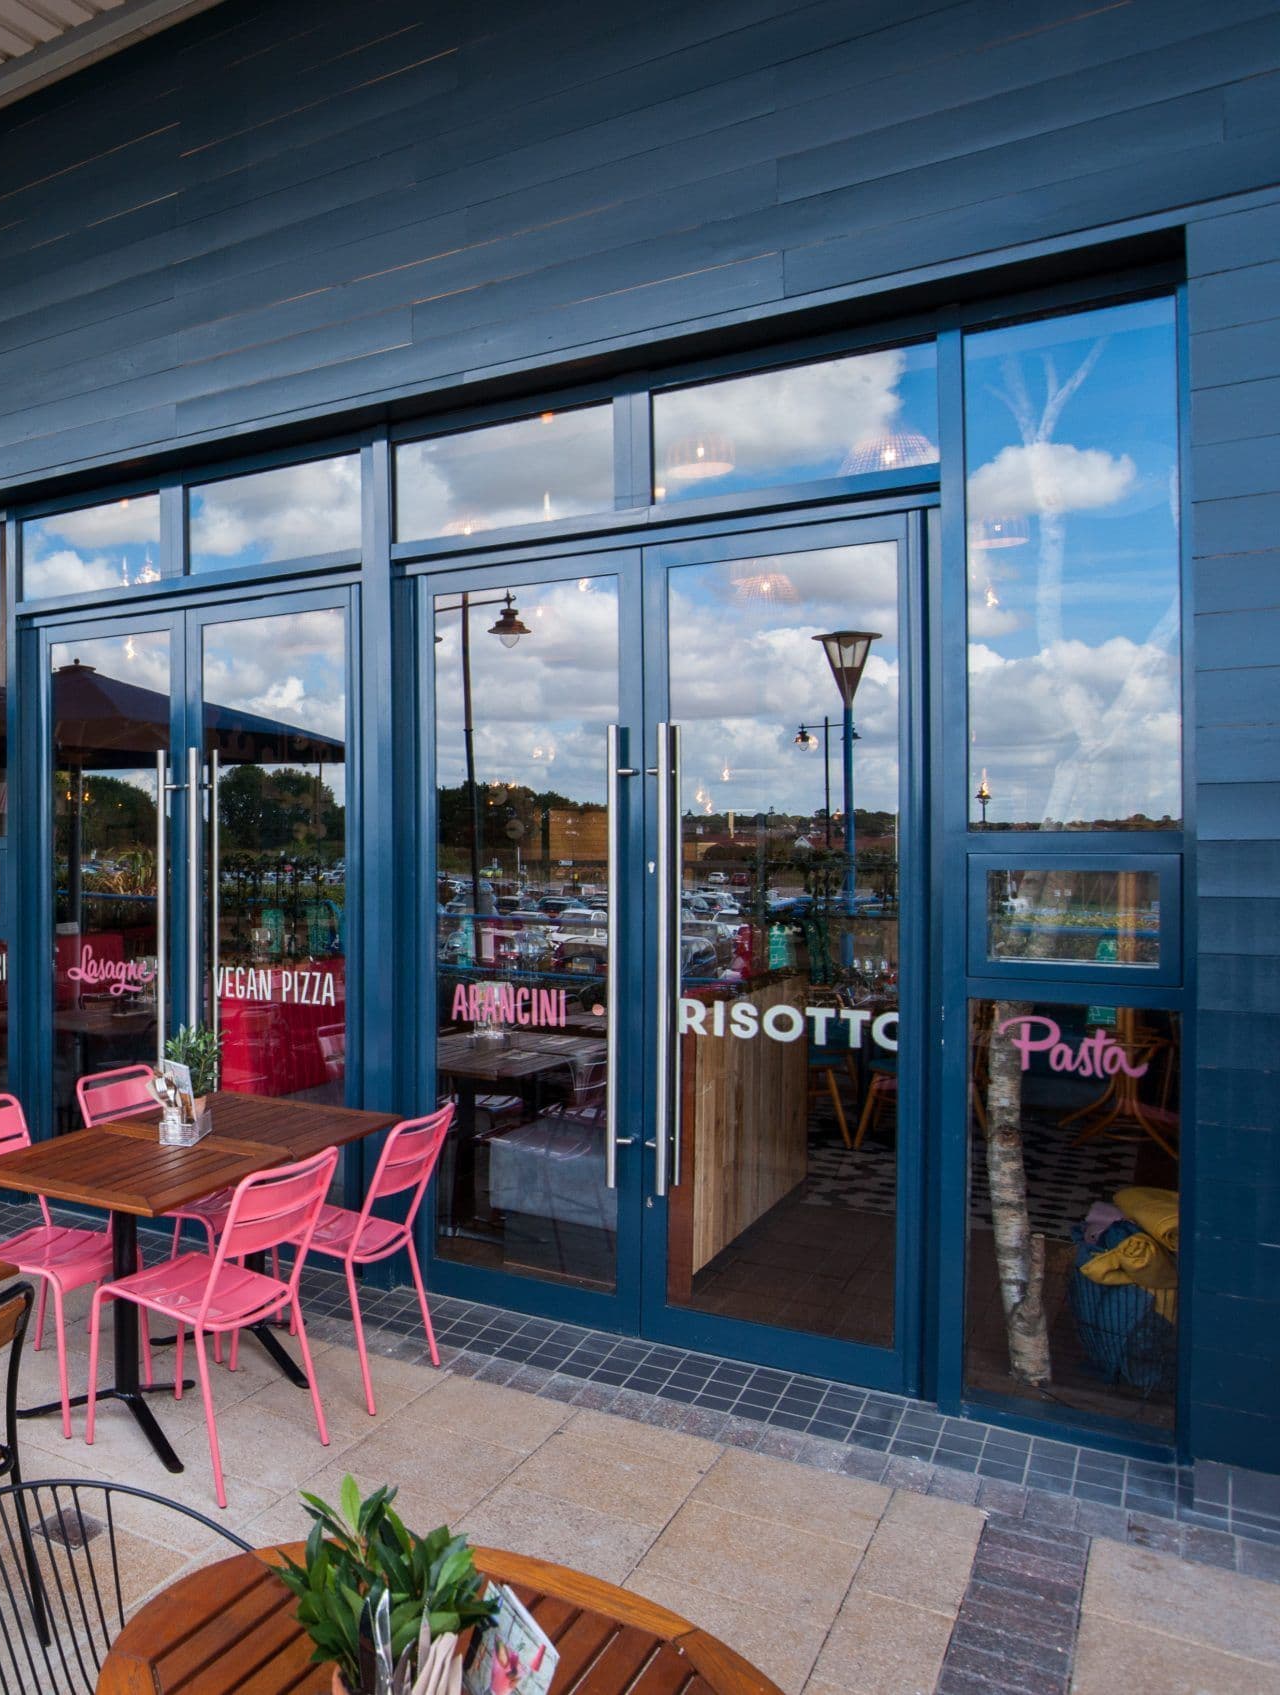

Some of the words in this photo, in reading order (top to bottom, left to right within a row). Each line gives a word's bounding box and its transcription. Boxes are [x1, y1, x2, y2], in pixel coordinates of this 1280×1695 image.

[67, 944, 155, 996] Lasagne
[213, 966, 272, 1001] VEGAN
[281, 970, 336, 1007] PIZZA
[451, 983, 566, 1028] ARANCINI
[679, 998, 899, 1050] RISOTTO
[998, 1015, 1149, 1079] Pasta
